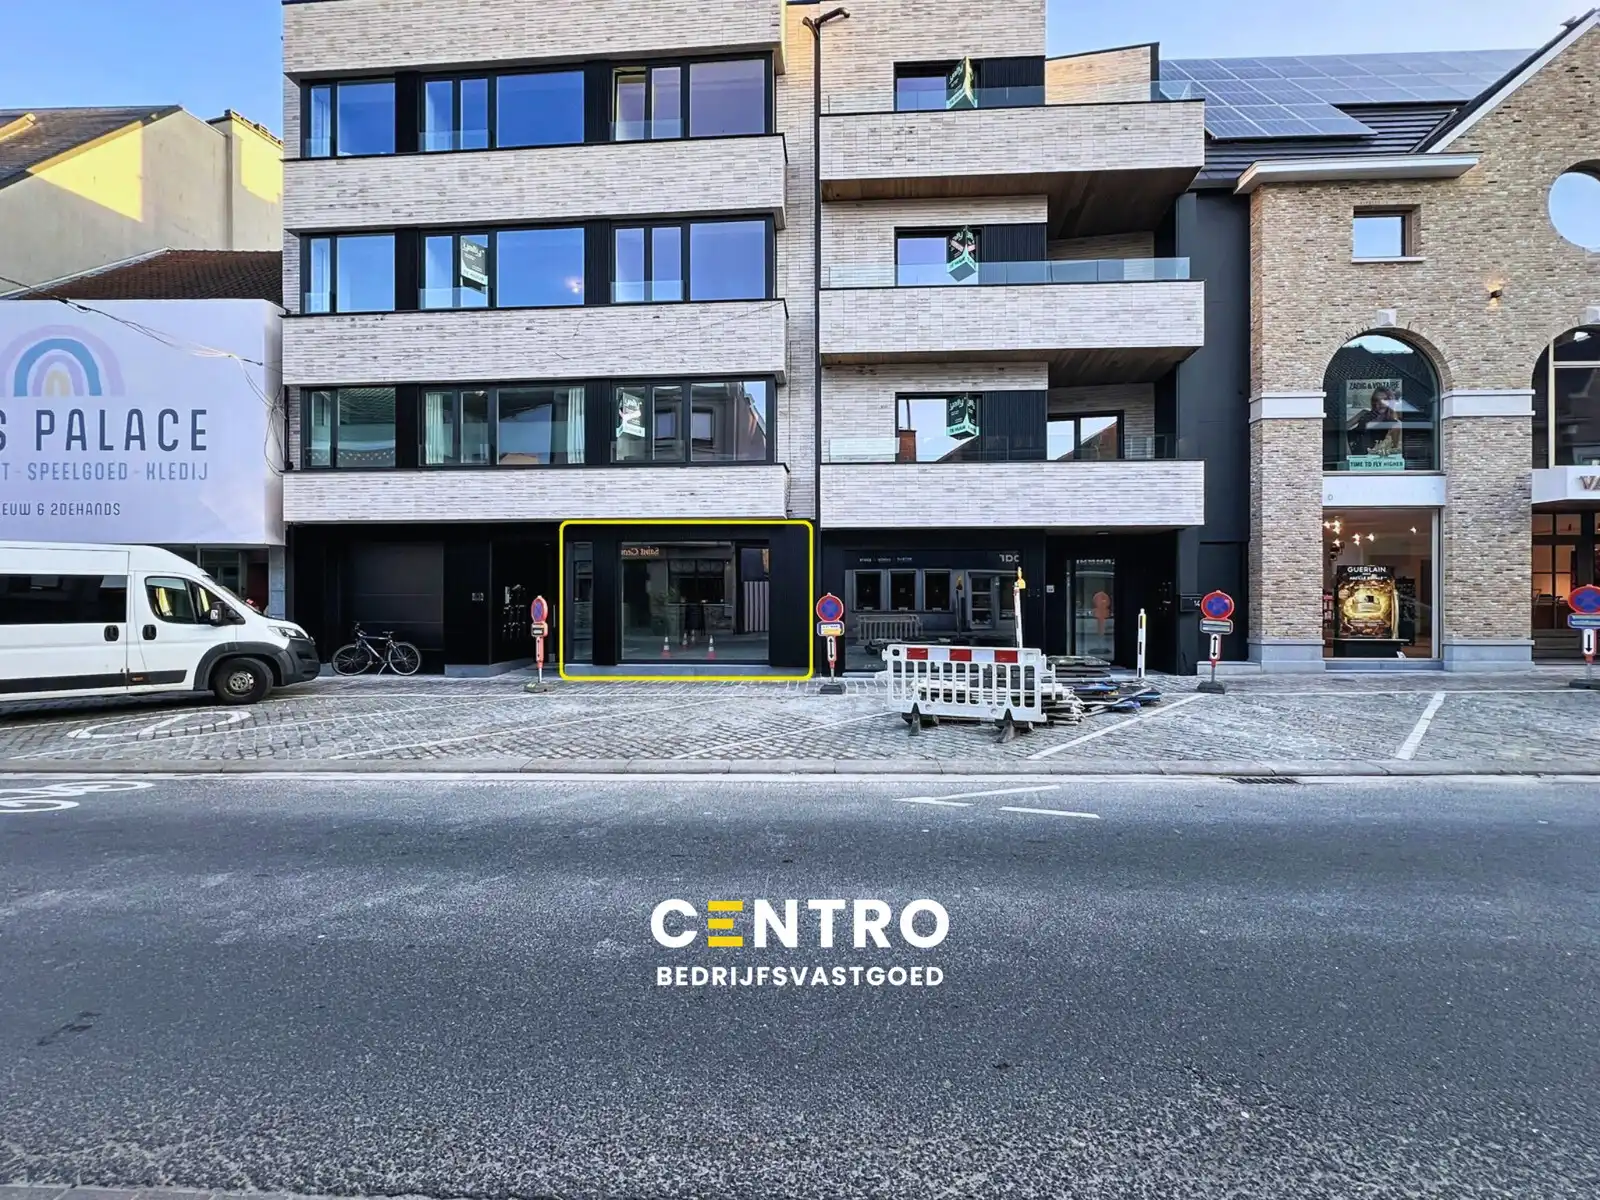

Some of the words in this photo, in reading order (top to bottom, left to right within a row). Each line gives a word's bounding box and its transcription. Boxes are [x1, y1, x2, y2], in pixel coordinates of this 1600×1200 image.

[36, 409, 207, 451] PALACE
[28, 462, 128, 481] SPEELGOED
[146, 462, 208, 482] KLEDIJ
